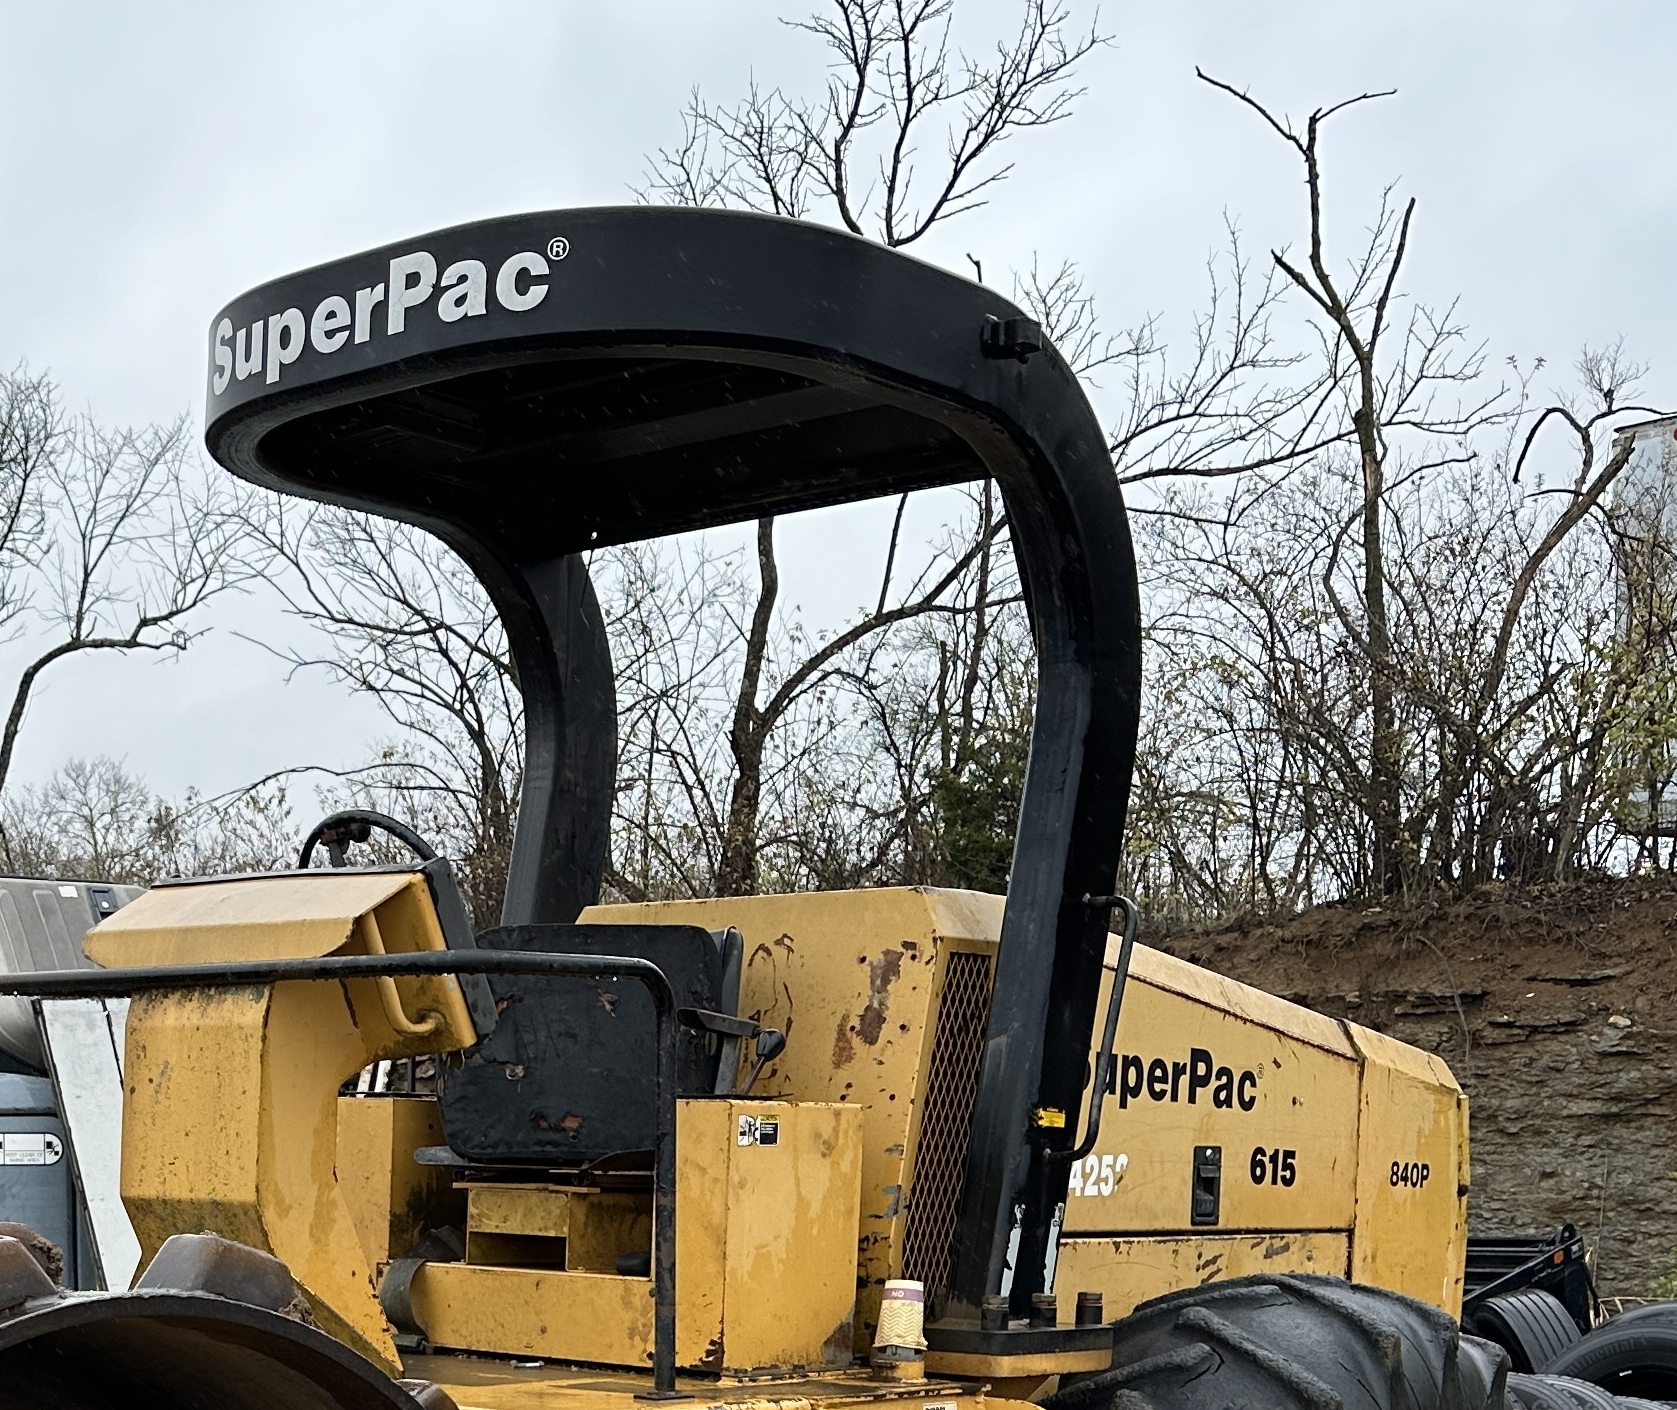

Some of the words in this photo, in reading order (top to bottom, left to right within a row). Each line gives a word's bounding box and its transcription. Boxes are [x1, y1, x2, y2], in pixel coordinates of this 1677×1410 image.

[1083, 1047, 1258, 1112] uperPac
[1250, 1146, 1297, 1188] 615
[1389, 1161, 1430, 1189] 840P
